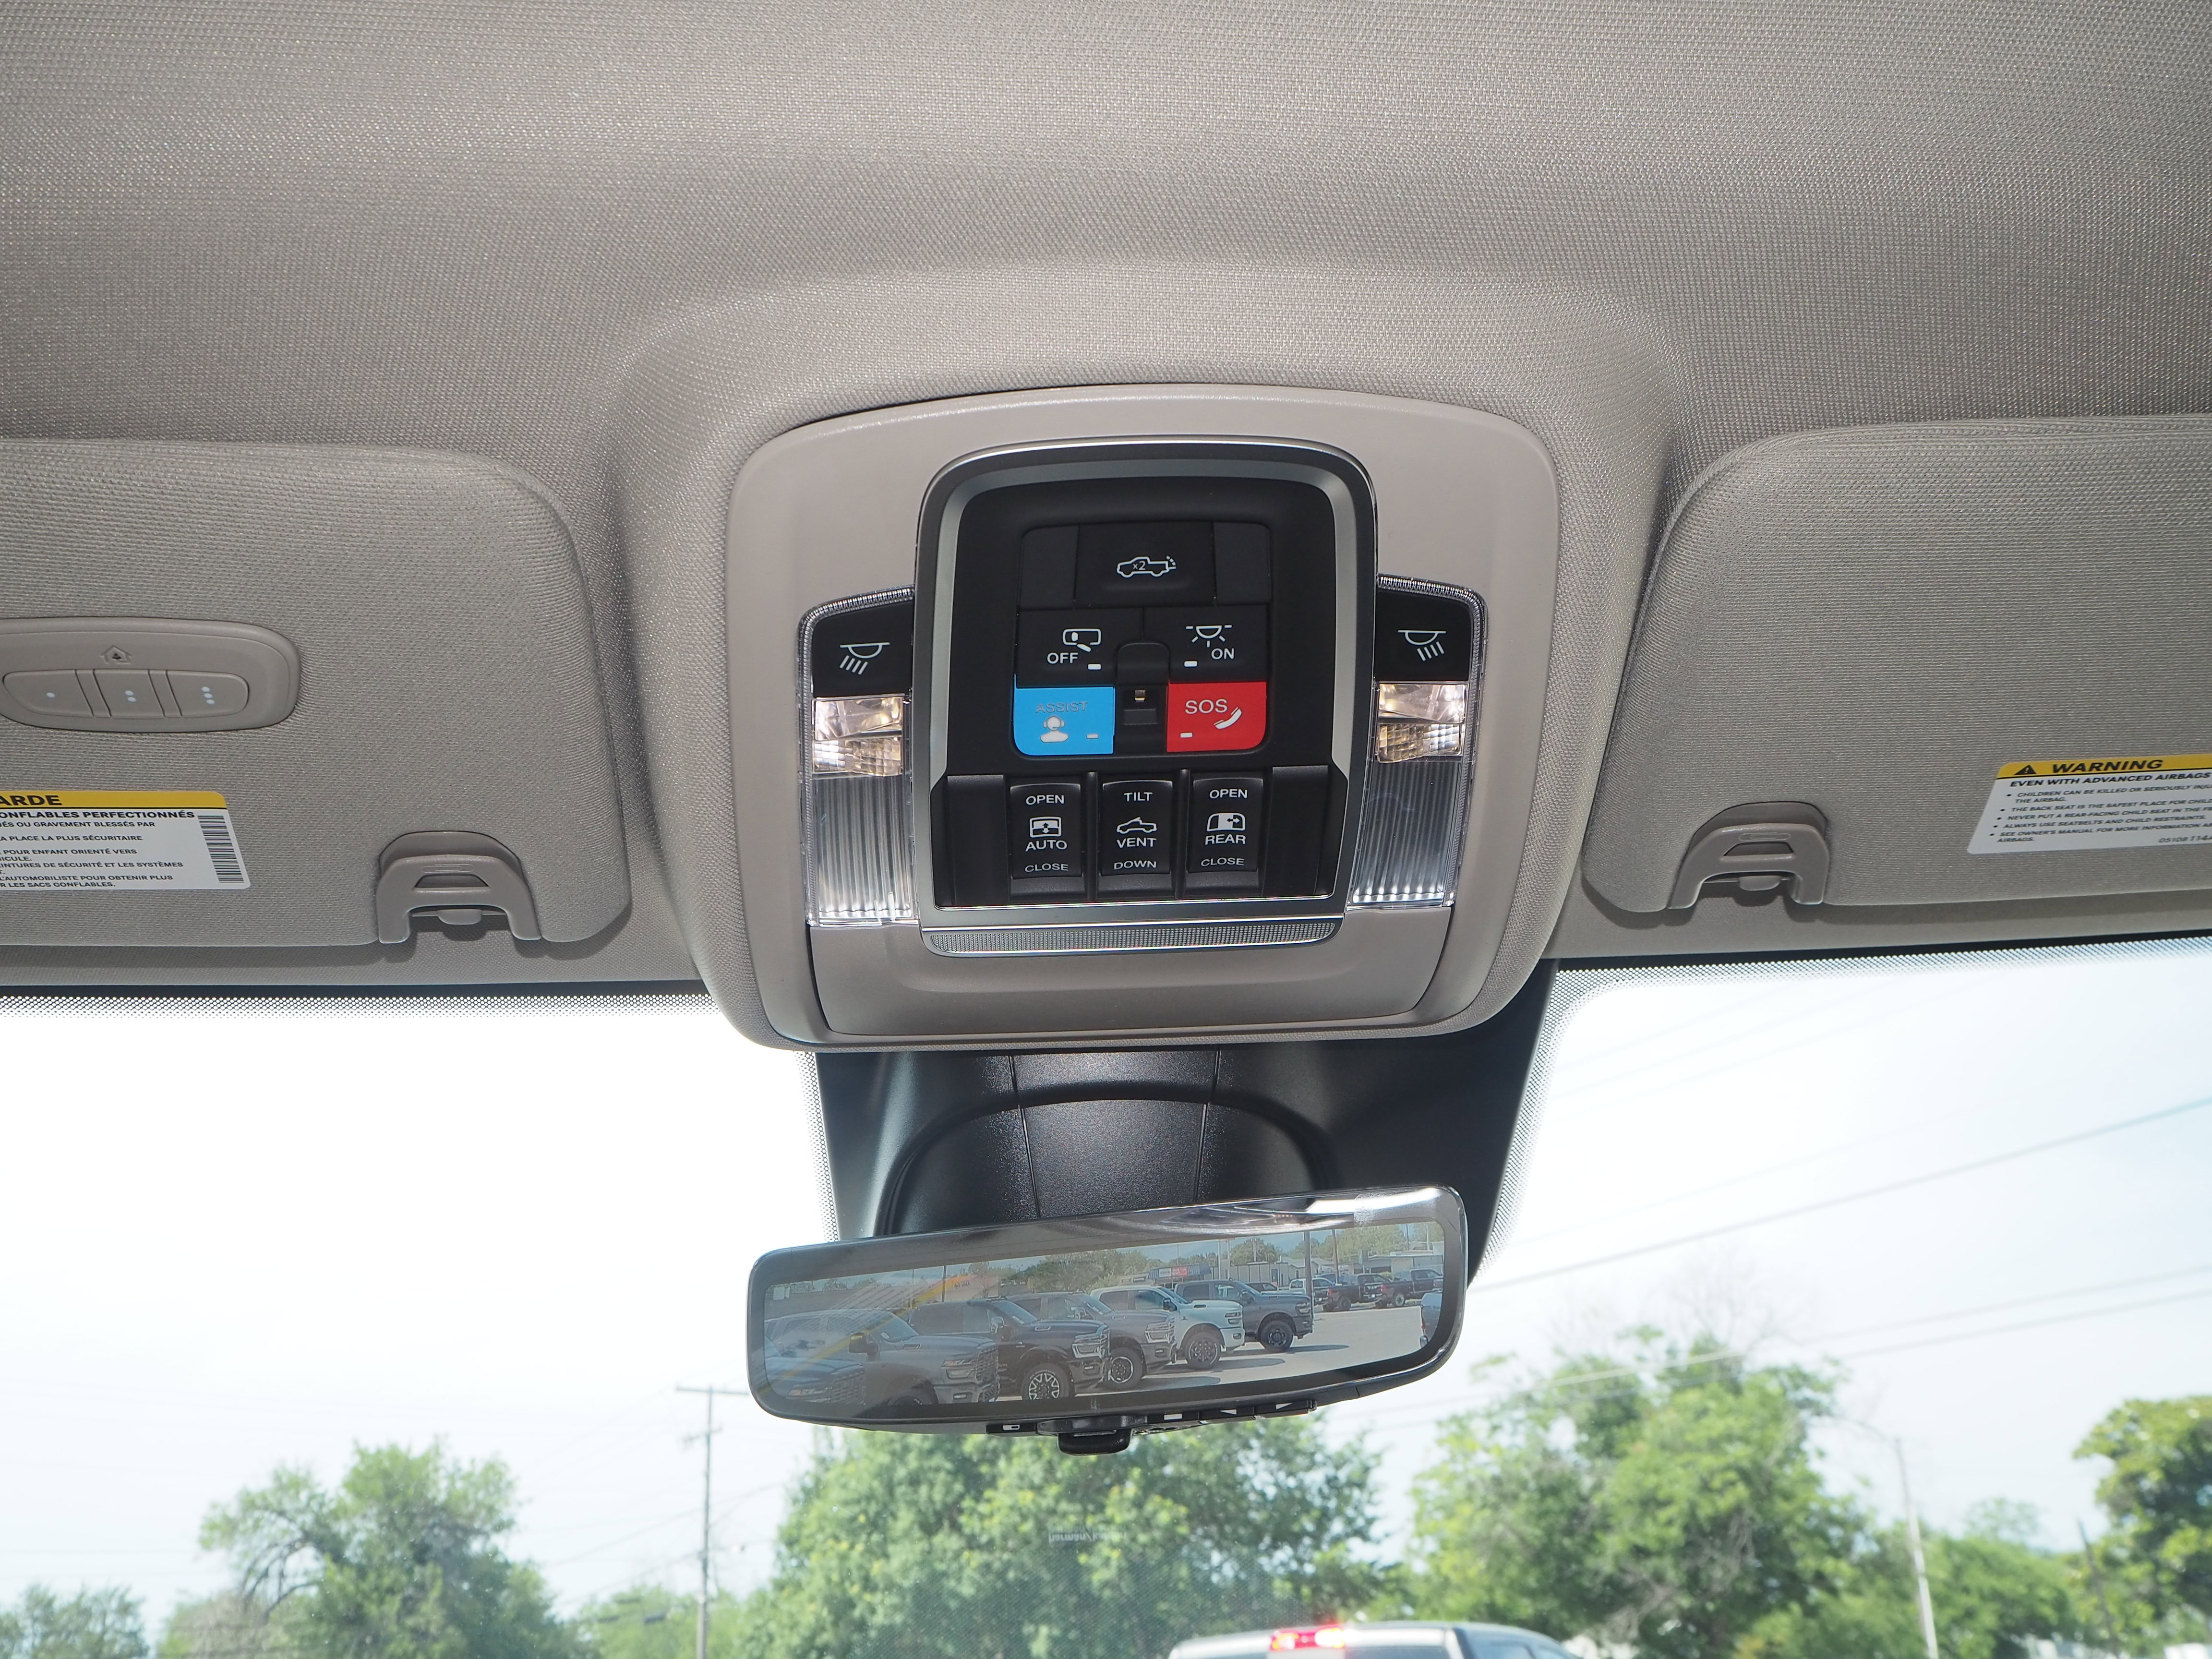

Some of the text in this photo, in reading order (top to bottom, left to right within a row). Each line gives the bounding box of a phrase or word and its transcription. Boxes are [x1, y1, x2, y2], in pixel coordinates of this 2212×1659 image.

[1046, 652, 1079, 664] OFF
[1211, 648, 1235, 660] ON
[1035, 701, 1088, 714] ASSIST
[1185, 698, 1227, 714] SOS
[2053, 759, 2164, 773] WARNING
[2082, 775, 2152, 783] ADVANCED
[2155, 772, 2212, 780] AIRBAGS
[1124, 791, 1153, 802] TILT
[1209, 788, 1248, 799] OPEN
[1025, 794, 1064, 805] OPEN
[82, 810, 195, 818] PERFECTIONNÉS
[1116, 837, 1157, 848] VENT
[1205, 834, 1246, 845] REAR
[1025, 840, 1068, 852] AUTO
[1114, 860, 1157, 870] DOWN
[1201, 857, 1245, 867] CLOSE
[1024, 863, 1069, 873] CLOSE
